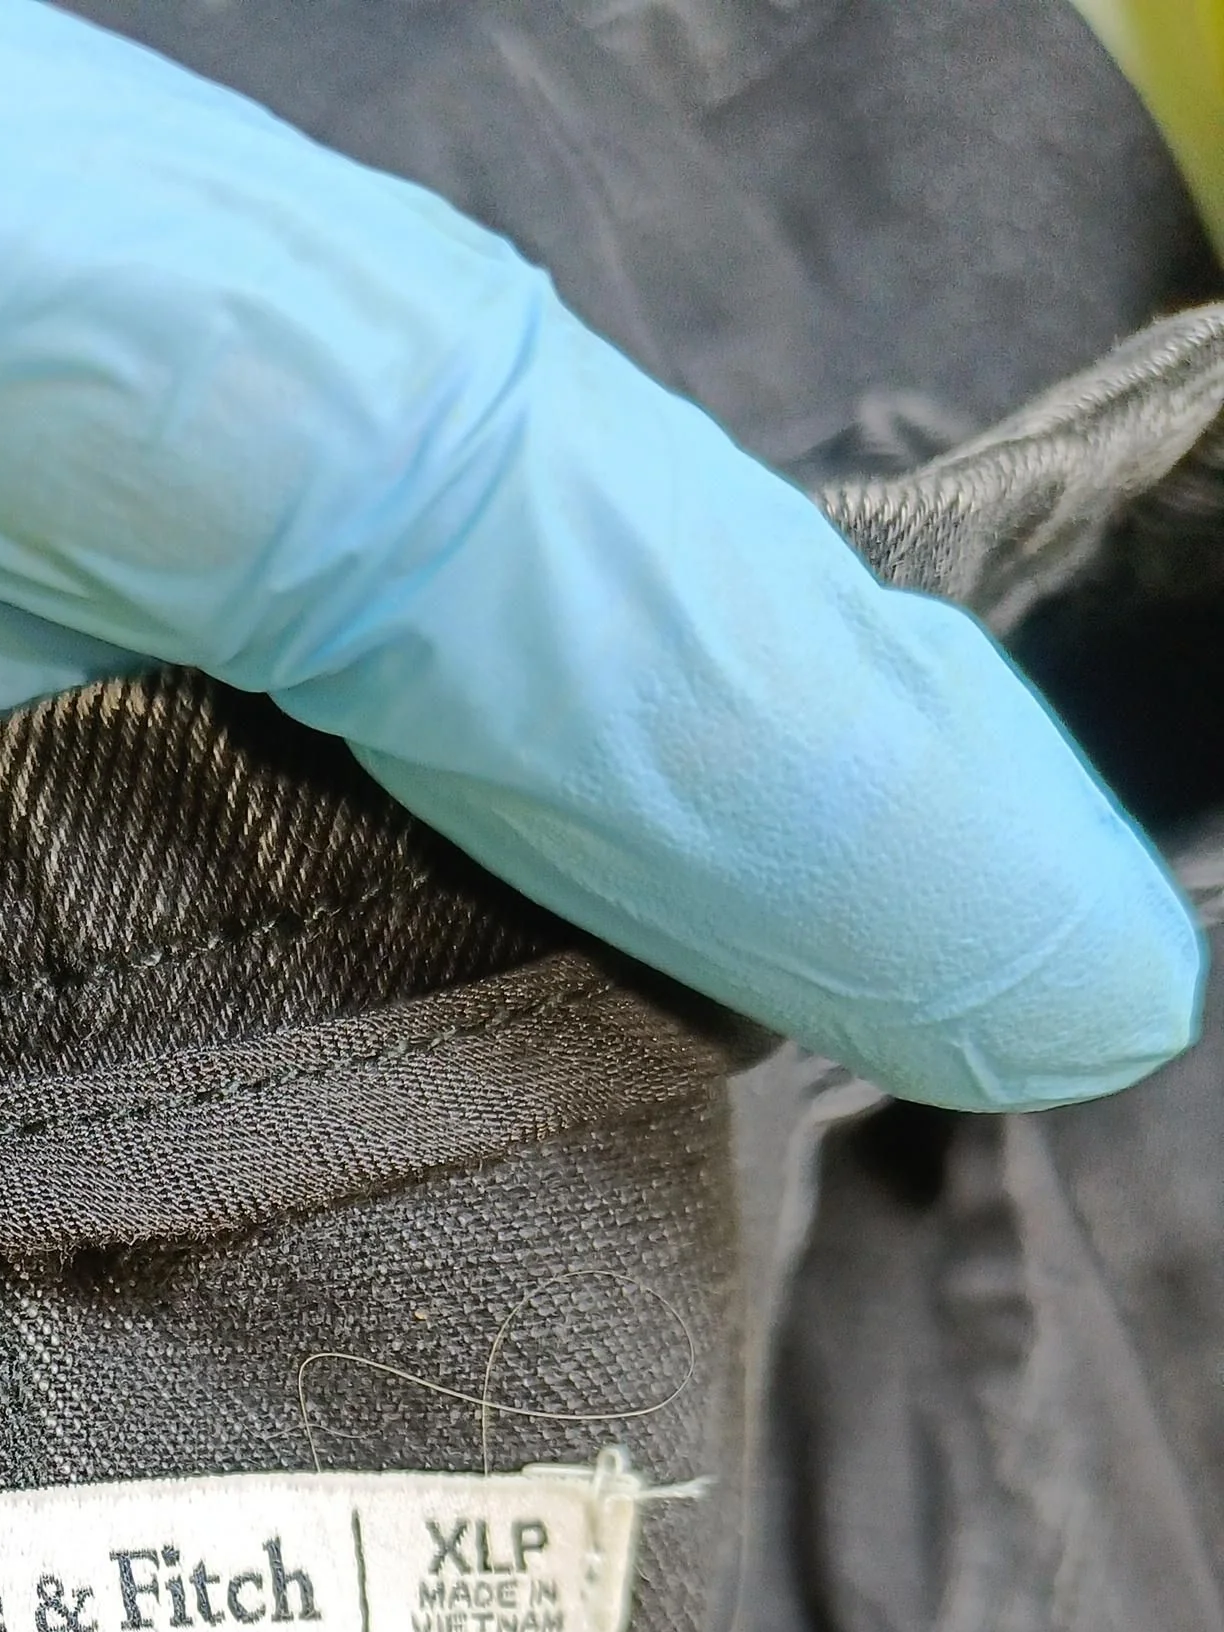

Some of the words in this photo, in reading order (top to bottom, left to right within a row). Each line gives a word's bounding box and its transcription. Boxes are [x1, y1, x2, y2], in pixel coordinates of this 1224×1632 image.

[425, 1518, 549, 1575] XLP
[109, 1537, 322, 1631] Fitch
[419, 1579, 518, 1611] MADE
[528, 1579, 558, 1608] IN
